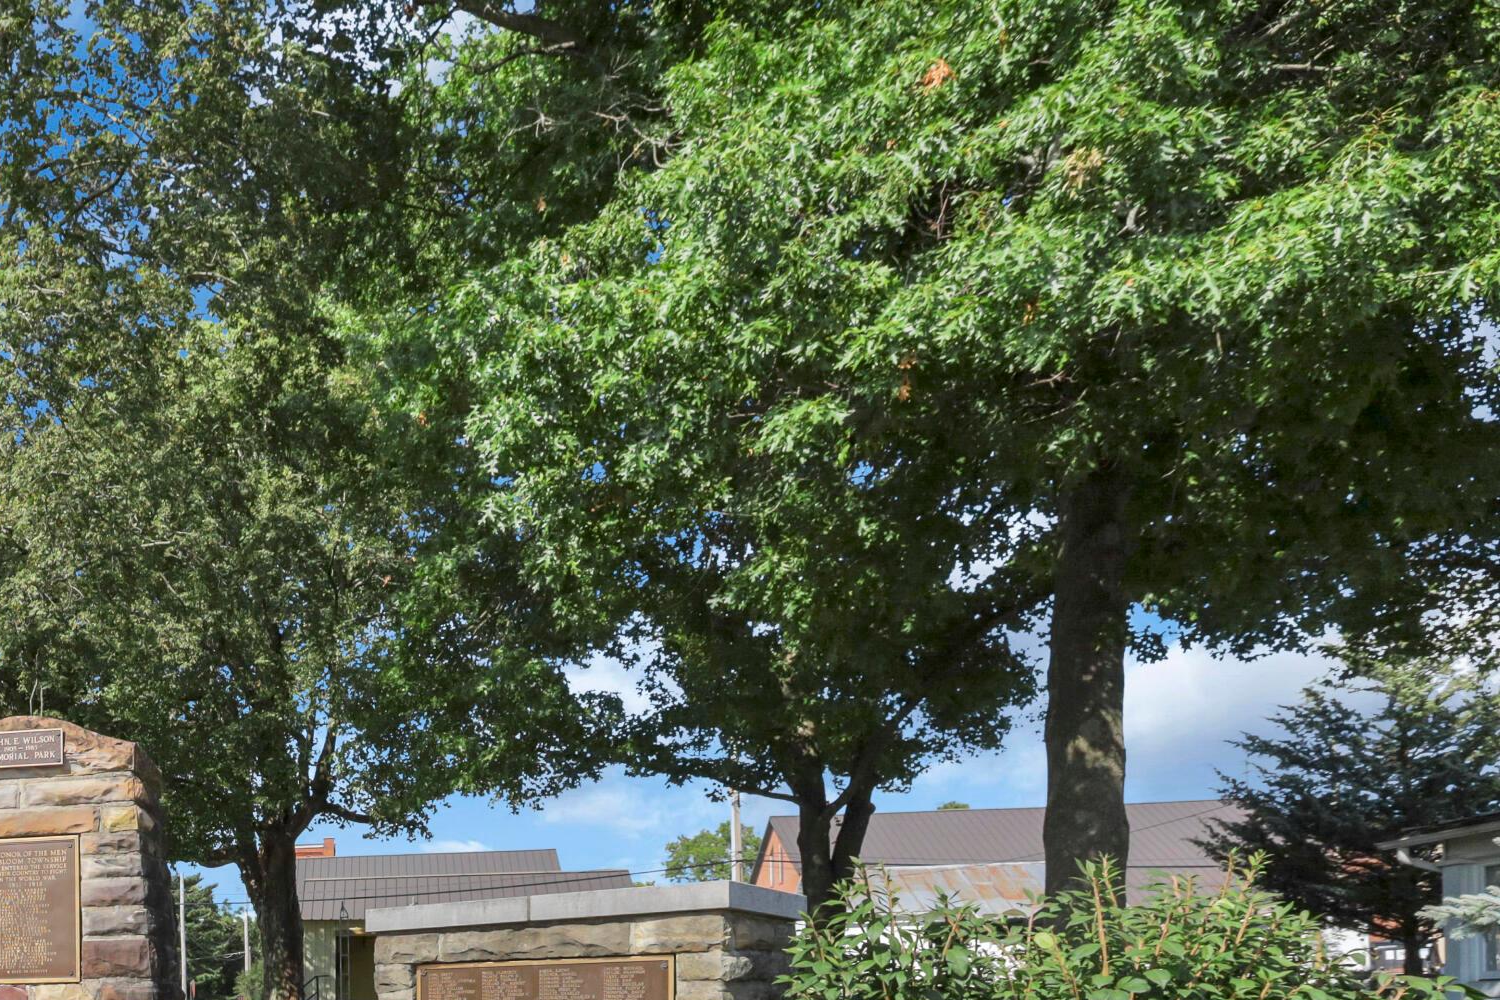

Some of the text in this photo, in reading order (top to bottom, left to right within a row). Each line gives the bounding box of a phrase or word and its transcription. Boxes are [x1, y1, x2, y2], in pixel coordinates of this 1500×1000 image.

[23, 735, 55, 745] WILSON
[34, 750, 56, 759] PARK
[27, 856, 68, 864] TOWNSHIP
